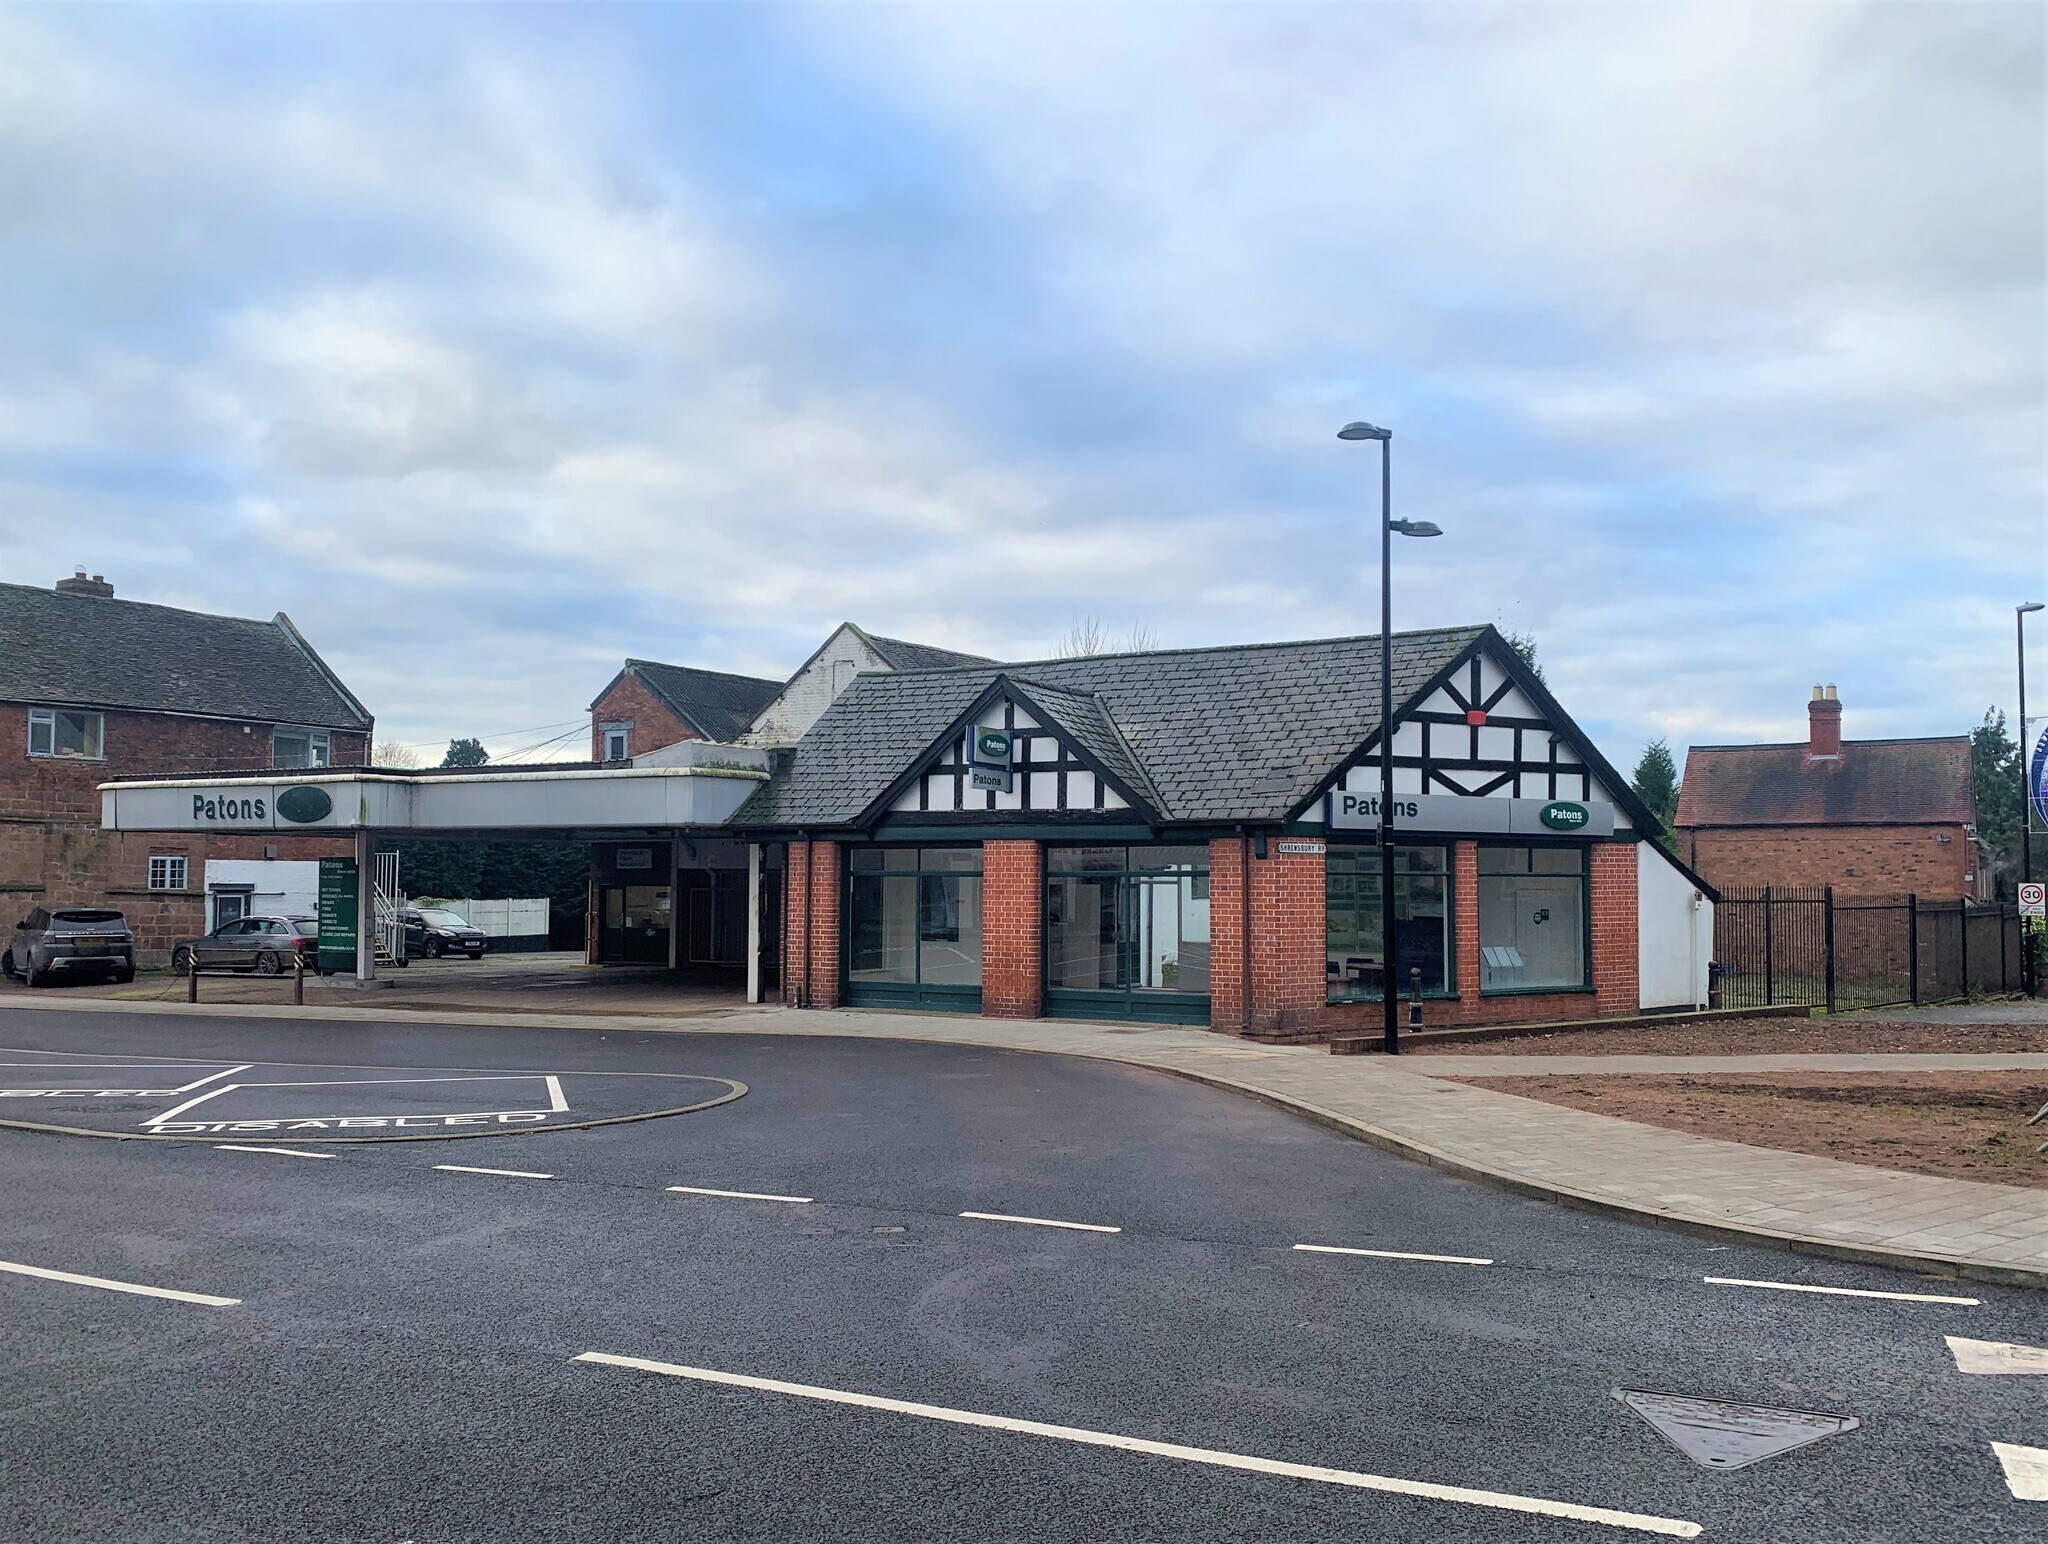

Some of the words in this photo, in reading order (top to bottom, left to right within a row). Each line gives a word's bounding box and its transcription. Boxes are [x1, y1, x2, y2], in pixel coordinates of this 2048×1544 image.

[987, 740, 1006, 749] Patons
[973, 774, 1001, 785] Patons
[193, 795, 266, 819] Patons
[1343, 796, 1418, 817] Patns
[1551, 809, 1582, 819] Patons
[148, 1112, 547, 1134] DISABLED
